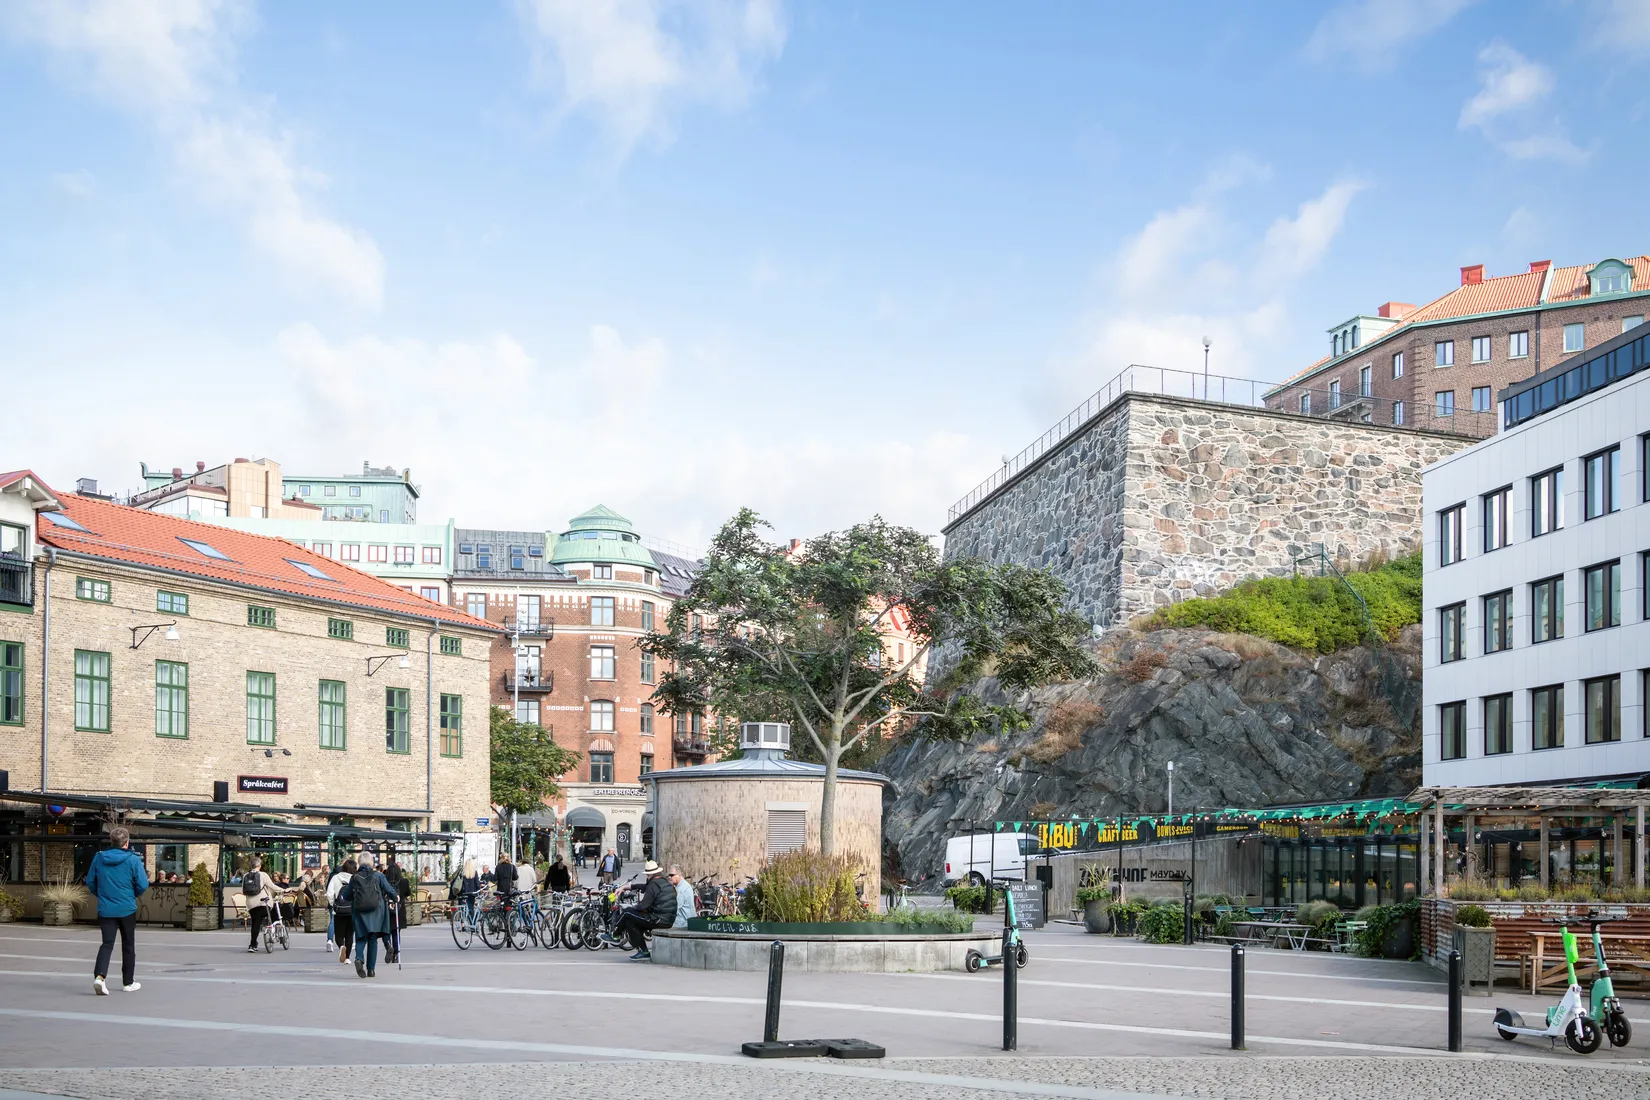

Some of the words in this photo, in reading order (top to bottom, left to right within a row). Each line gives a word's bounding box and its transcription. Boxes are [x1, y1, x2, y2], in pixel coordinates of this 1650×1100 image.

[243, 779, 284, 788] Språkcaféet
[1098, 829, 1119, 842] CRAFT
[1122, 829, 1138, 840] BEER
